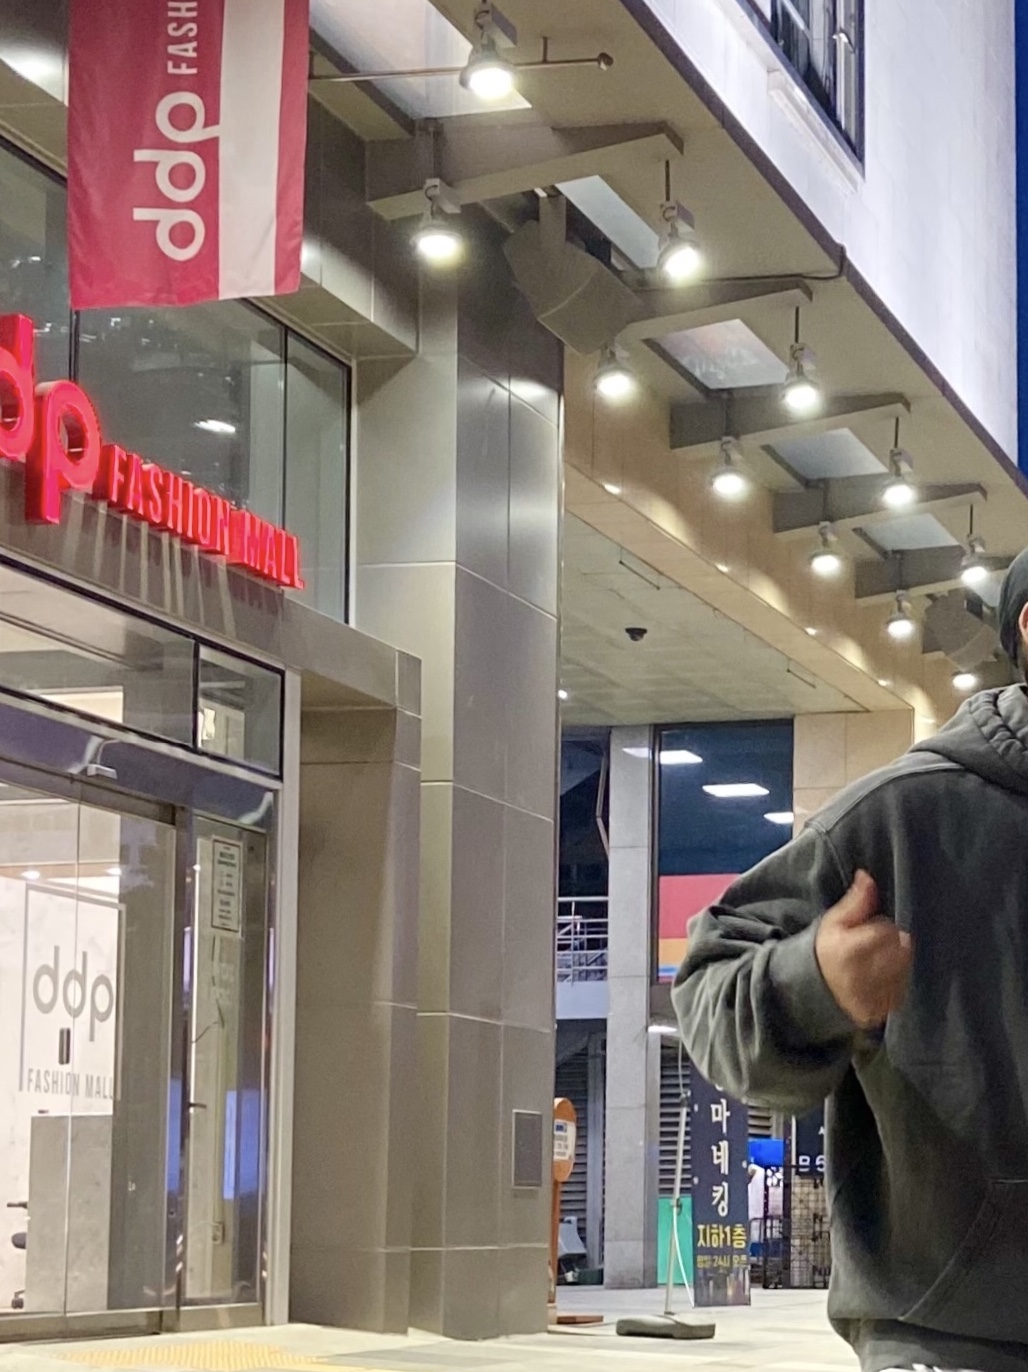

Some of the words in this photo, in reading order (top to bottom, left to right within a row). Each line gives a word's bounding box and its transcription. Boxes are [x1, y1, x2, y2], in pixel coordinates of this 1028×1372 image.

[133, 91, 220, 261] ddp
[108, 444, 231, 556] FASHION
[238, 508, 304, 590] MALL
[33, 945, 114, 1042] ddp
[27, 1068, 80, 1098] FASHION
[710, 1083, 732, 1218] 마네킹
[696, 1223, 748, 1250] 지하1층
